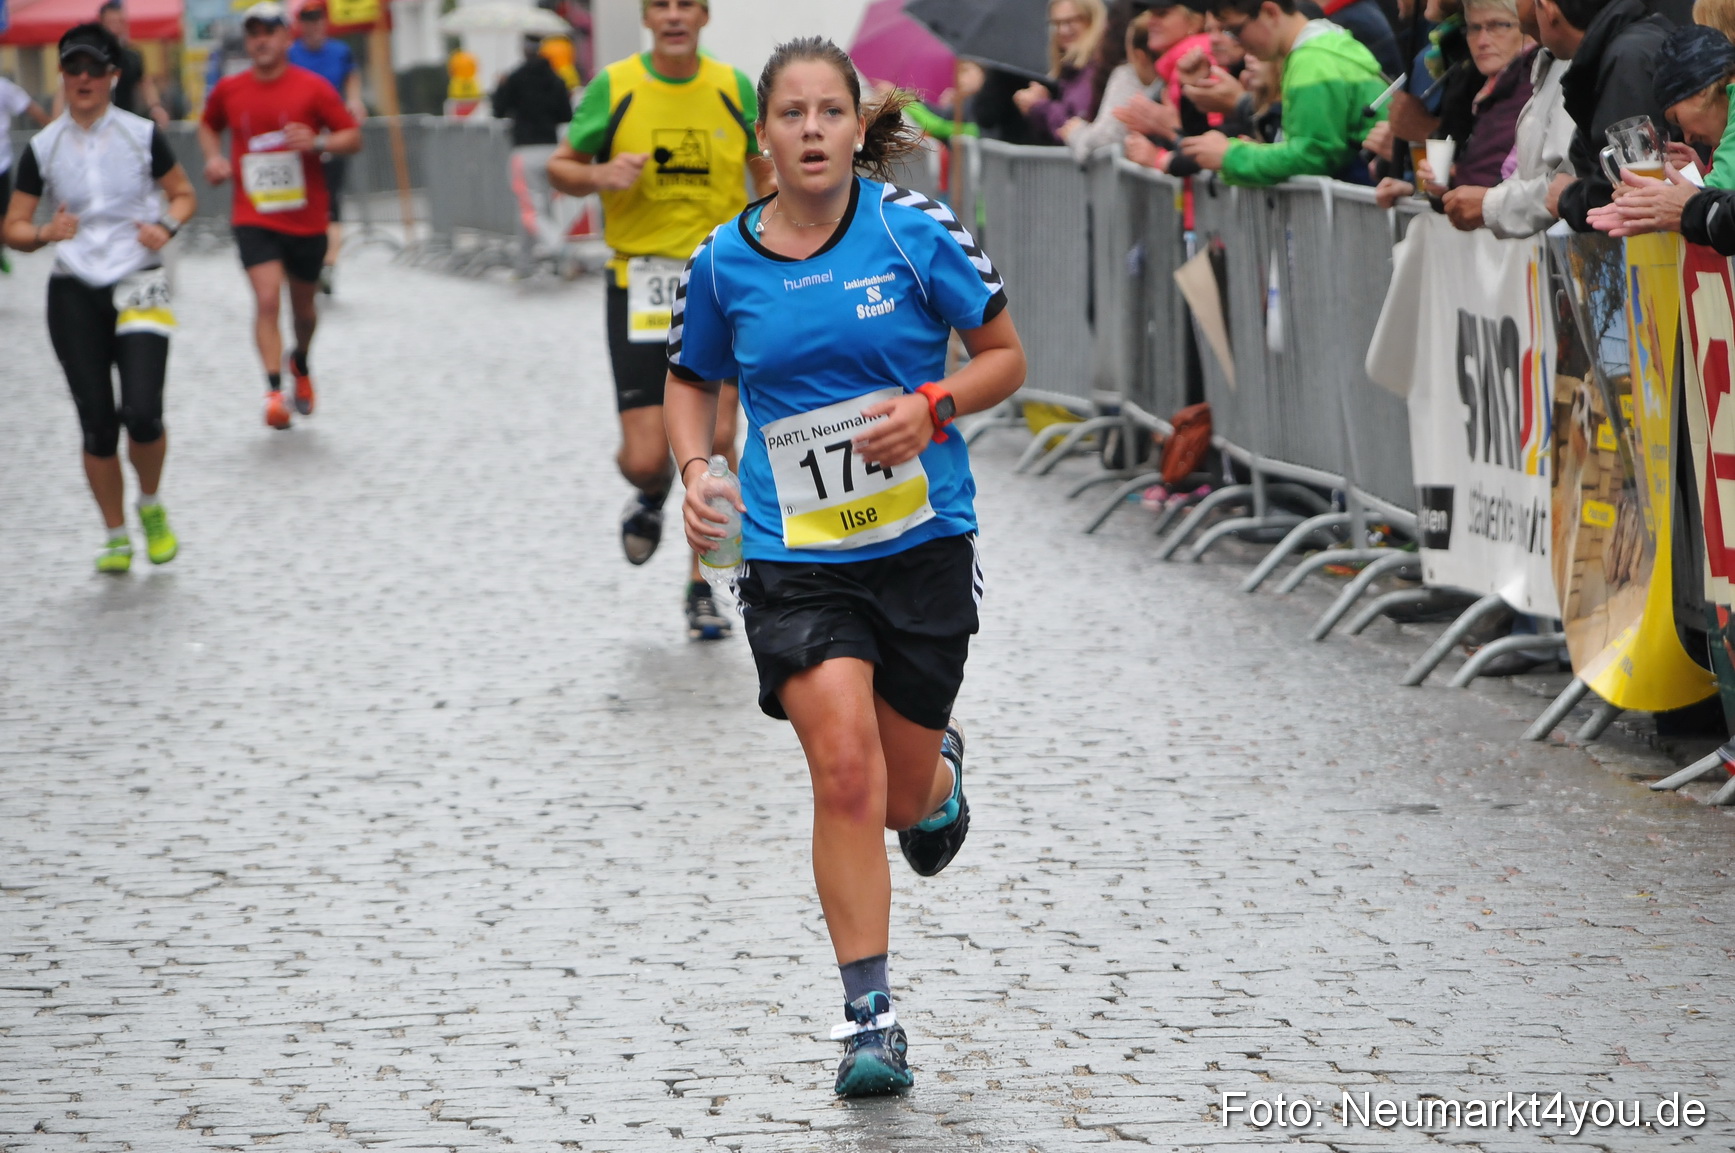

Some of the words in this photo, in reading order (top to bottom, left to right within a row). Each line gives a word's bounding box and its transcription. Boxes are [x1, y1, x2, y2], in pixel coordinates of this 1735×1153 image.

[783, 269, 834, 292] hummel
[856, 298, 896, 319] Steubl
[768, 429, 810, 450] PARTL
[811, 413, 882, 439] Neumark
[839, 507, 879, 531] Ilse
